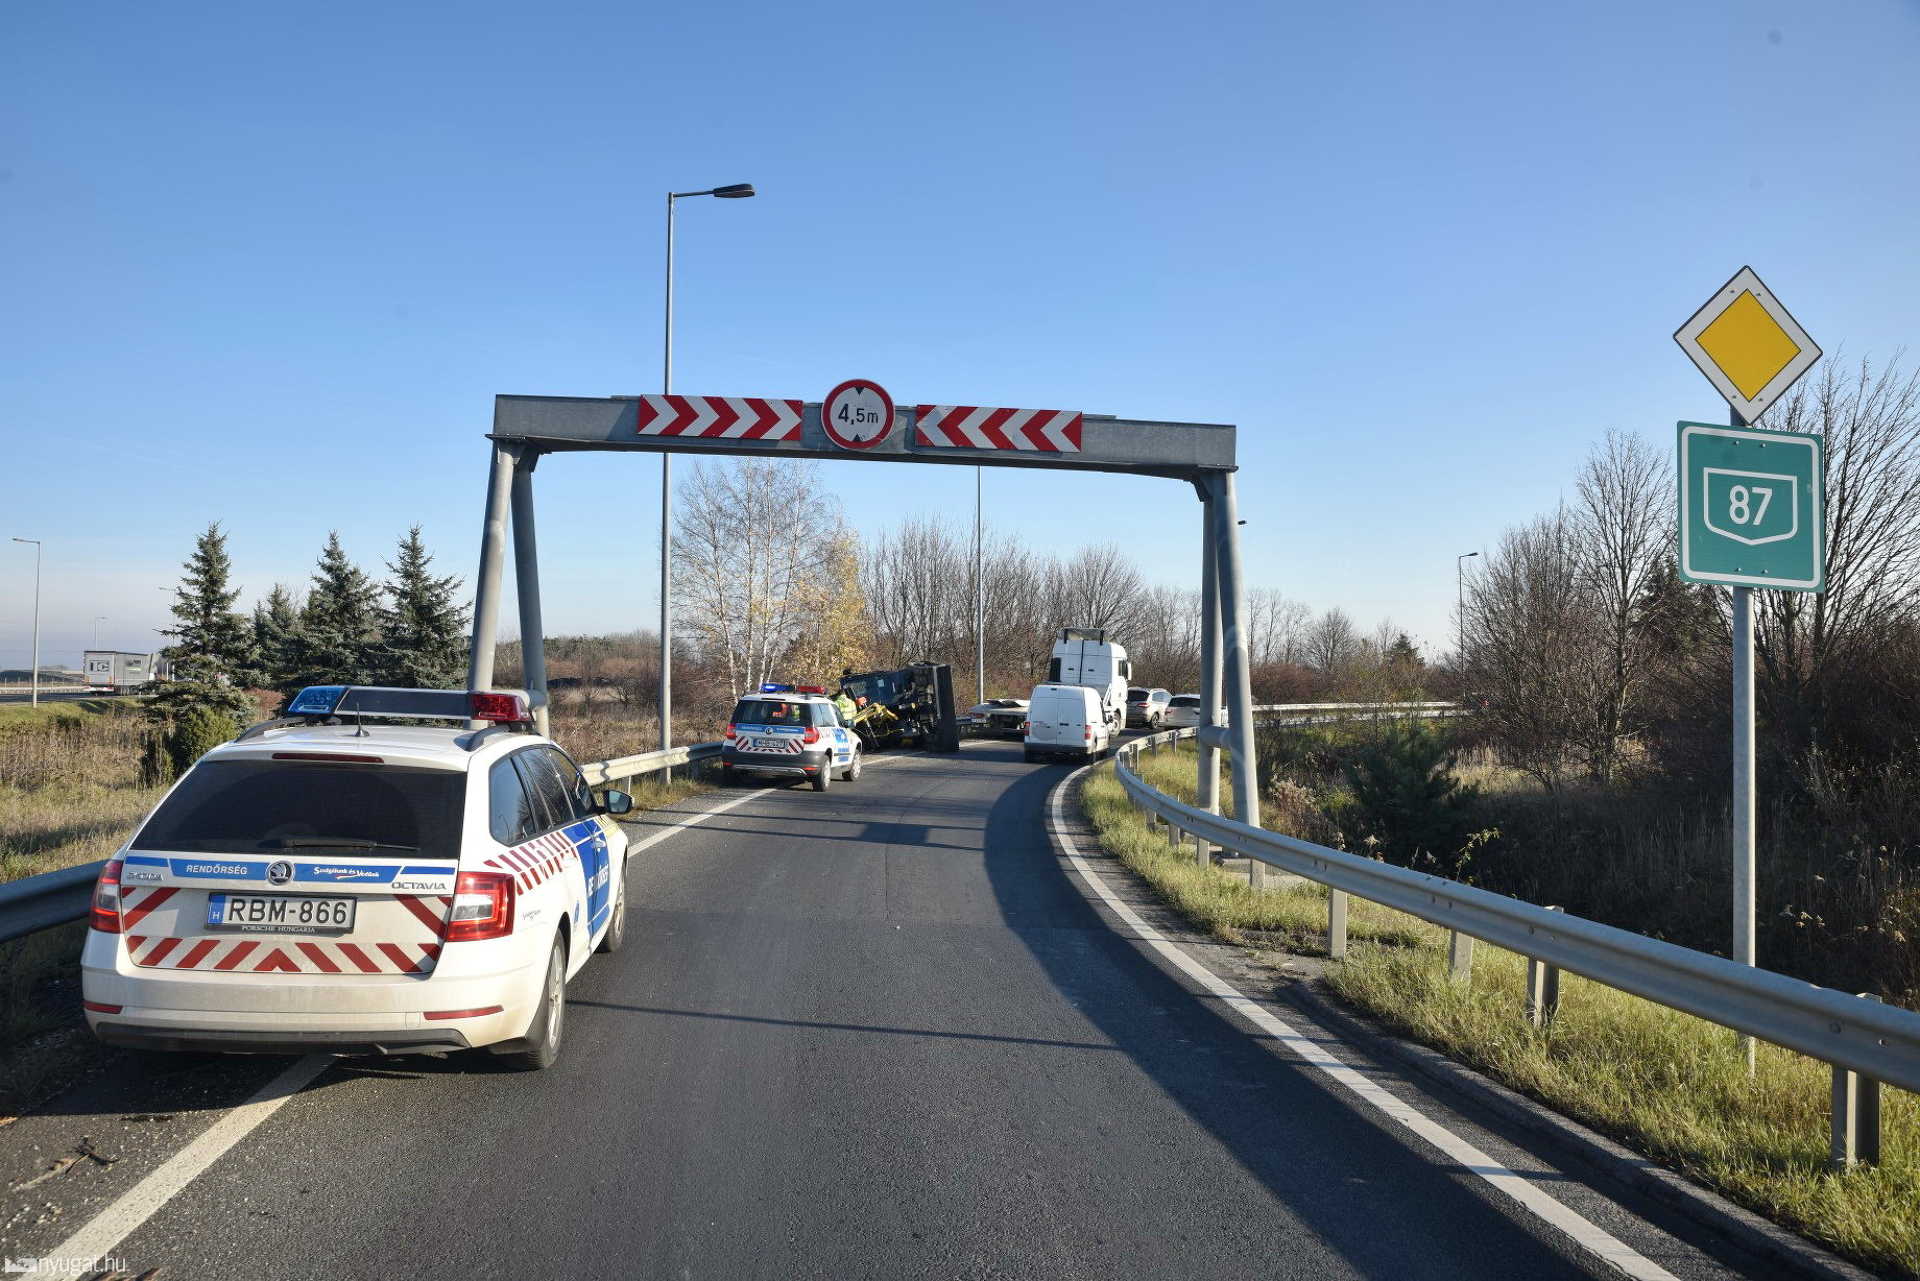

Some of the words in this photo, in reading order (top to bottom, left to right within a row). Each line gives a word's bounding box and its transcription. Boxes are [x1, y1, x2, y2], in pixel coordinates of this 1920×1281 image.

[1729, 485, 1773, 526] 87
[185, 863, 248, 875] RENDŐRSÉG
[391, 881, 447, 890] OCTAVIA
[212, 911, 220, 920] H
[228, 898, 347, 924] RBM-866
